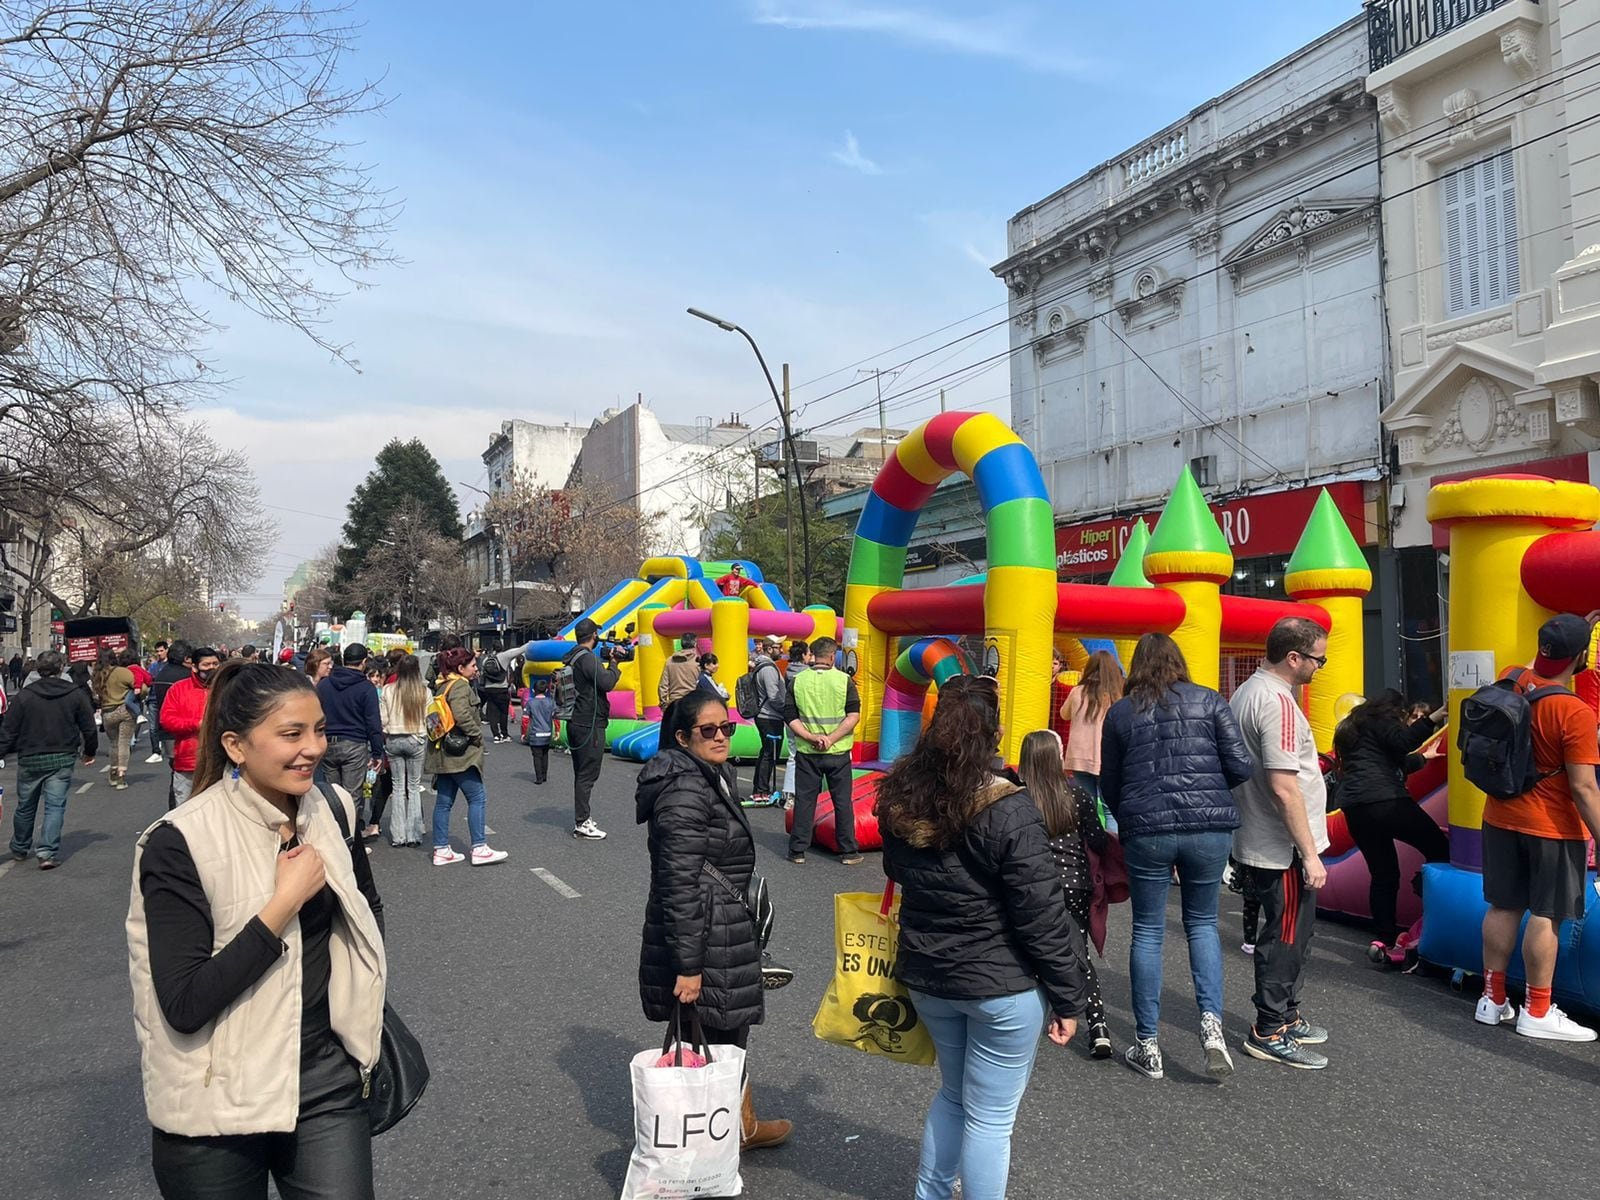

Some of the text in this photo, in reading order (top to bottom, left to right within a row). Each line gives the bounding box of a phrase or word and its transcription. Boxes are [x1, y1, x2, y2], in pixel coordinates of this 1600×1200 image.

[1080, 528, 1112, 547] Hiper
[1056, 549, 1108, 568] plásticos
[844, 932, 888, 951] ESTE
[843, 953, 861, 972] ES
[654, 1107, 730, 1148] LFC
